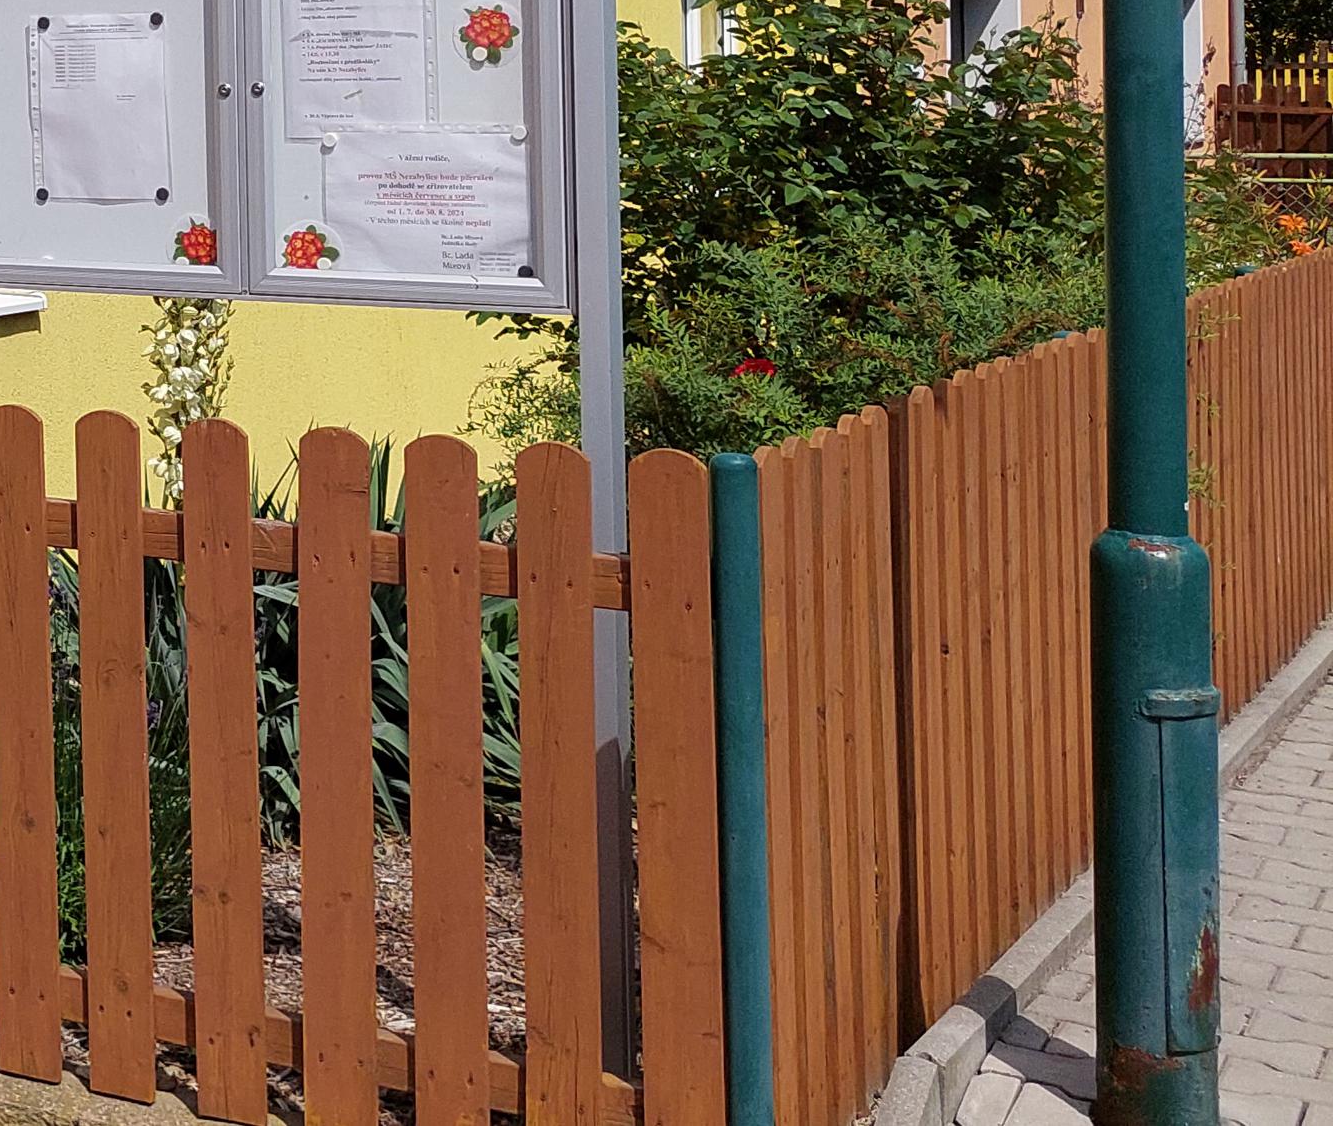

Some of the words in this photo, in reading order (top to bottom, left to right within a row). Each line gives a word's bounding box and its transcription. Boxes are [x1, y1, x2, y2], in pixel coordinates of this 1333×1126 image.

[399, 173, 437, 182] Nezabylice
[461, 174, 493, 182] přerušen
[442, 251, 452, 259] Bc.
[455, 251, 474, 259] Lada
